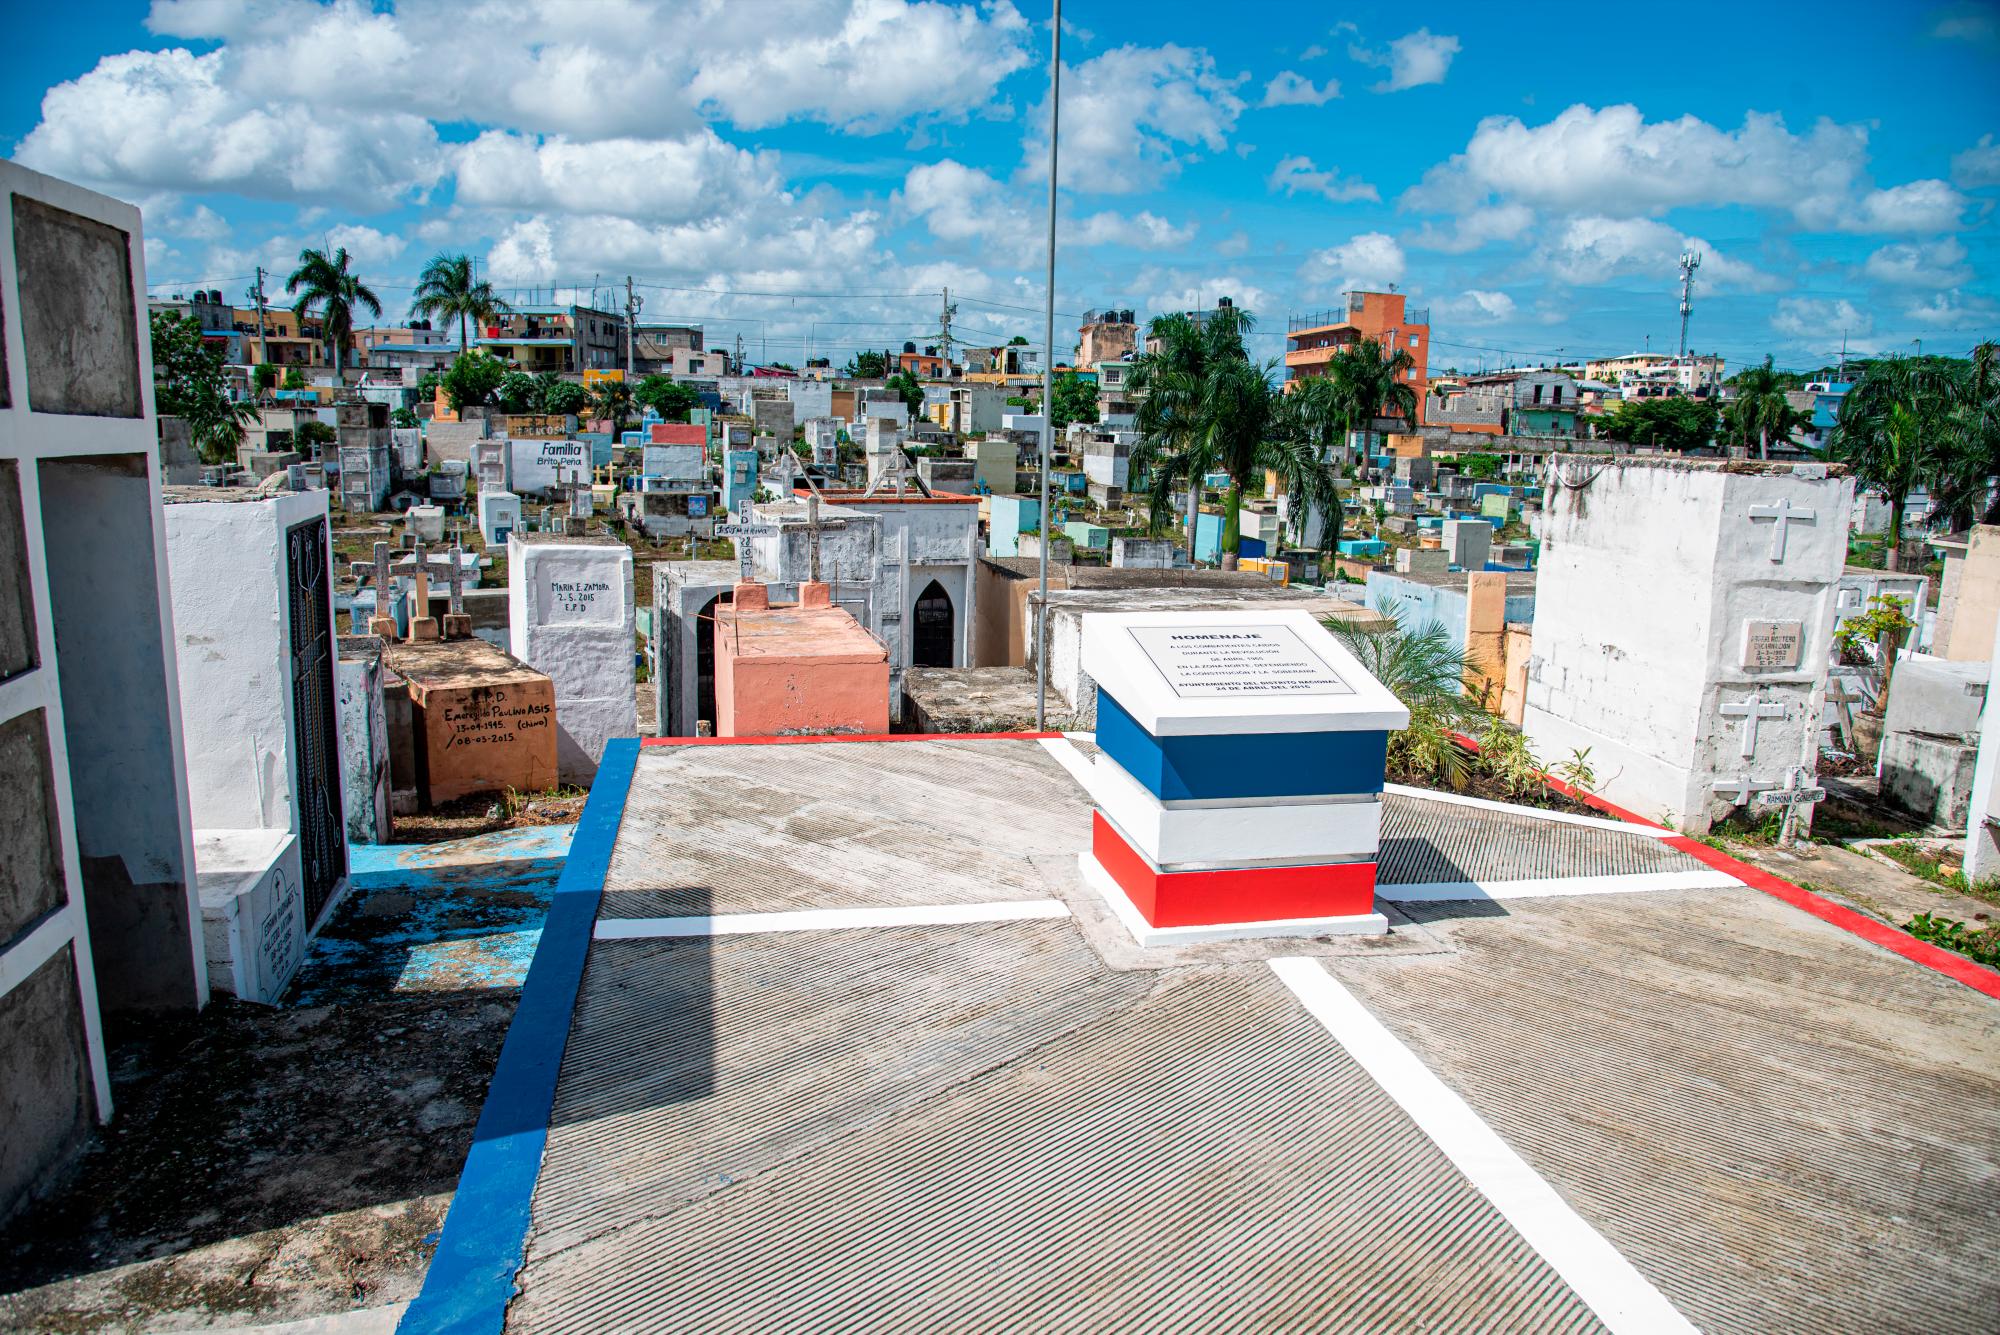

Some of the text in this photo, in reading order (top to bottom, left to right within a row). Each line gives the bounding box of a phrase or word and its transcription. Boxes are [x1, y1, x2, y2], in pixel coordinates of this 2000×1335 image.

[542, 442, 582, 456] Familia
[537, 457, 582, 466] Brito Peña
